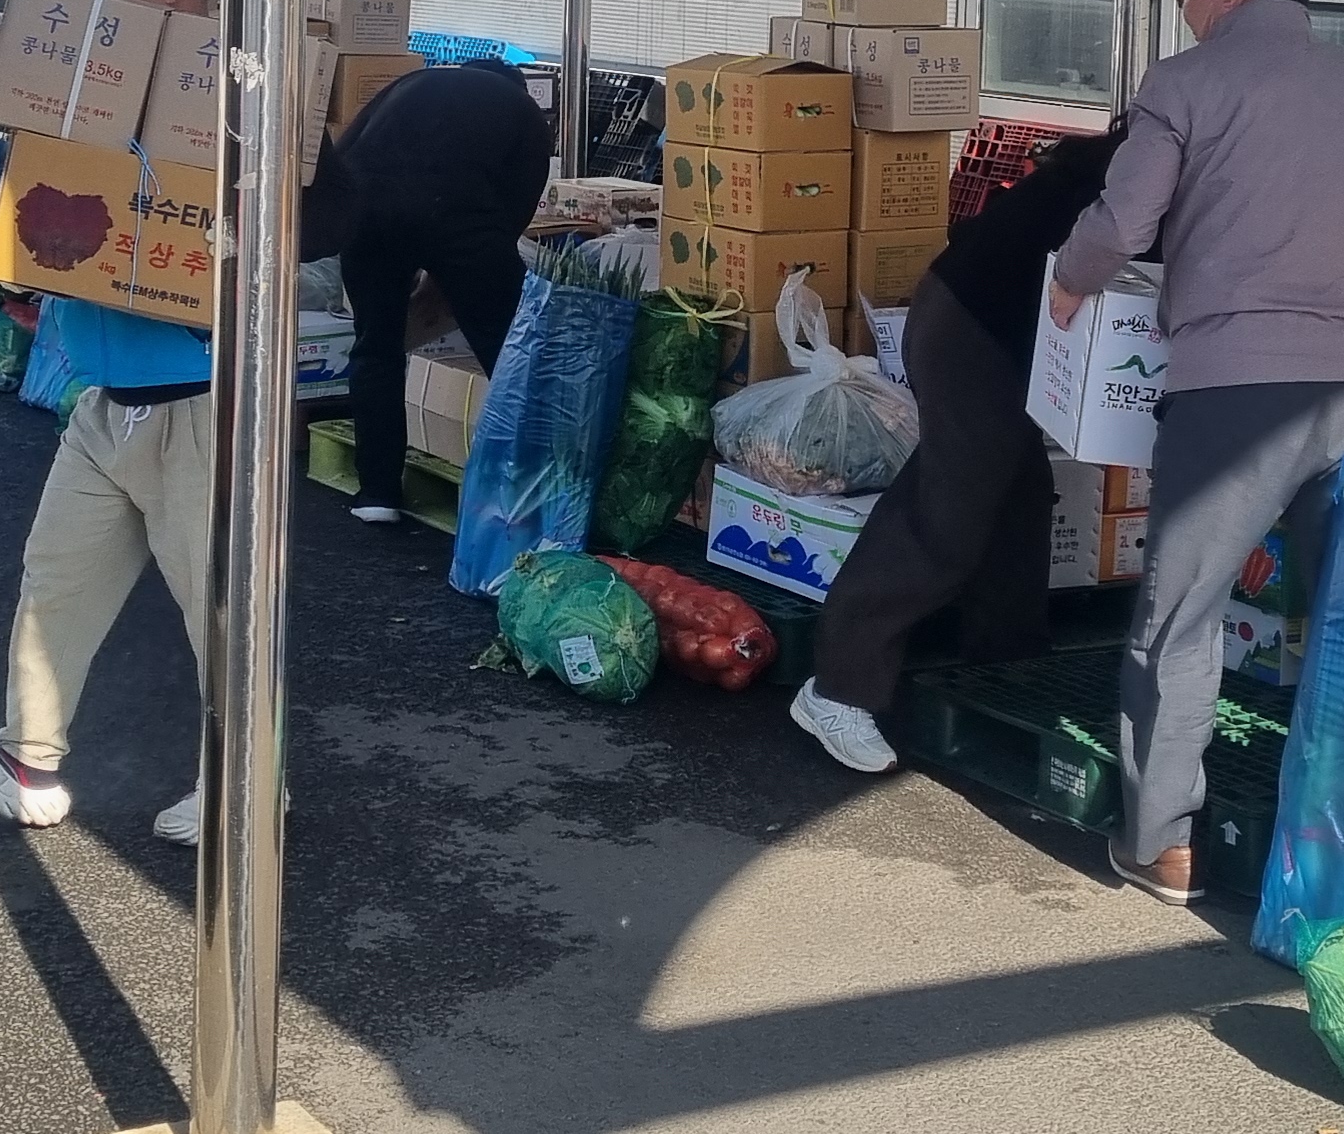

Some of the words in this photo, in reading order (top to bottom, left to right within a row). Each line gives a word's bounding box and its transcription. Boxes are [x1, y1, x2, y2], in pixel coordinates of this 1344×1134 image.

[42, 2, 120, 47] 수성
[21, 36, 77, 65] 콩나물
[84, 60, 124, 82] 3.5kg
[917, 57, 961, 74] 콩나물
[115, 233, 208, 276] 적상추
[1100, 402, 1133, 411] JINAN
[1137, 405, 1154, 413] GO
[790, 518, 803, 537] 무
